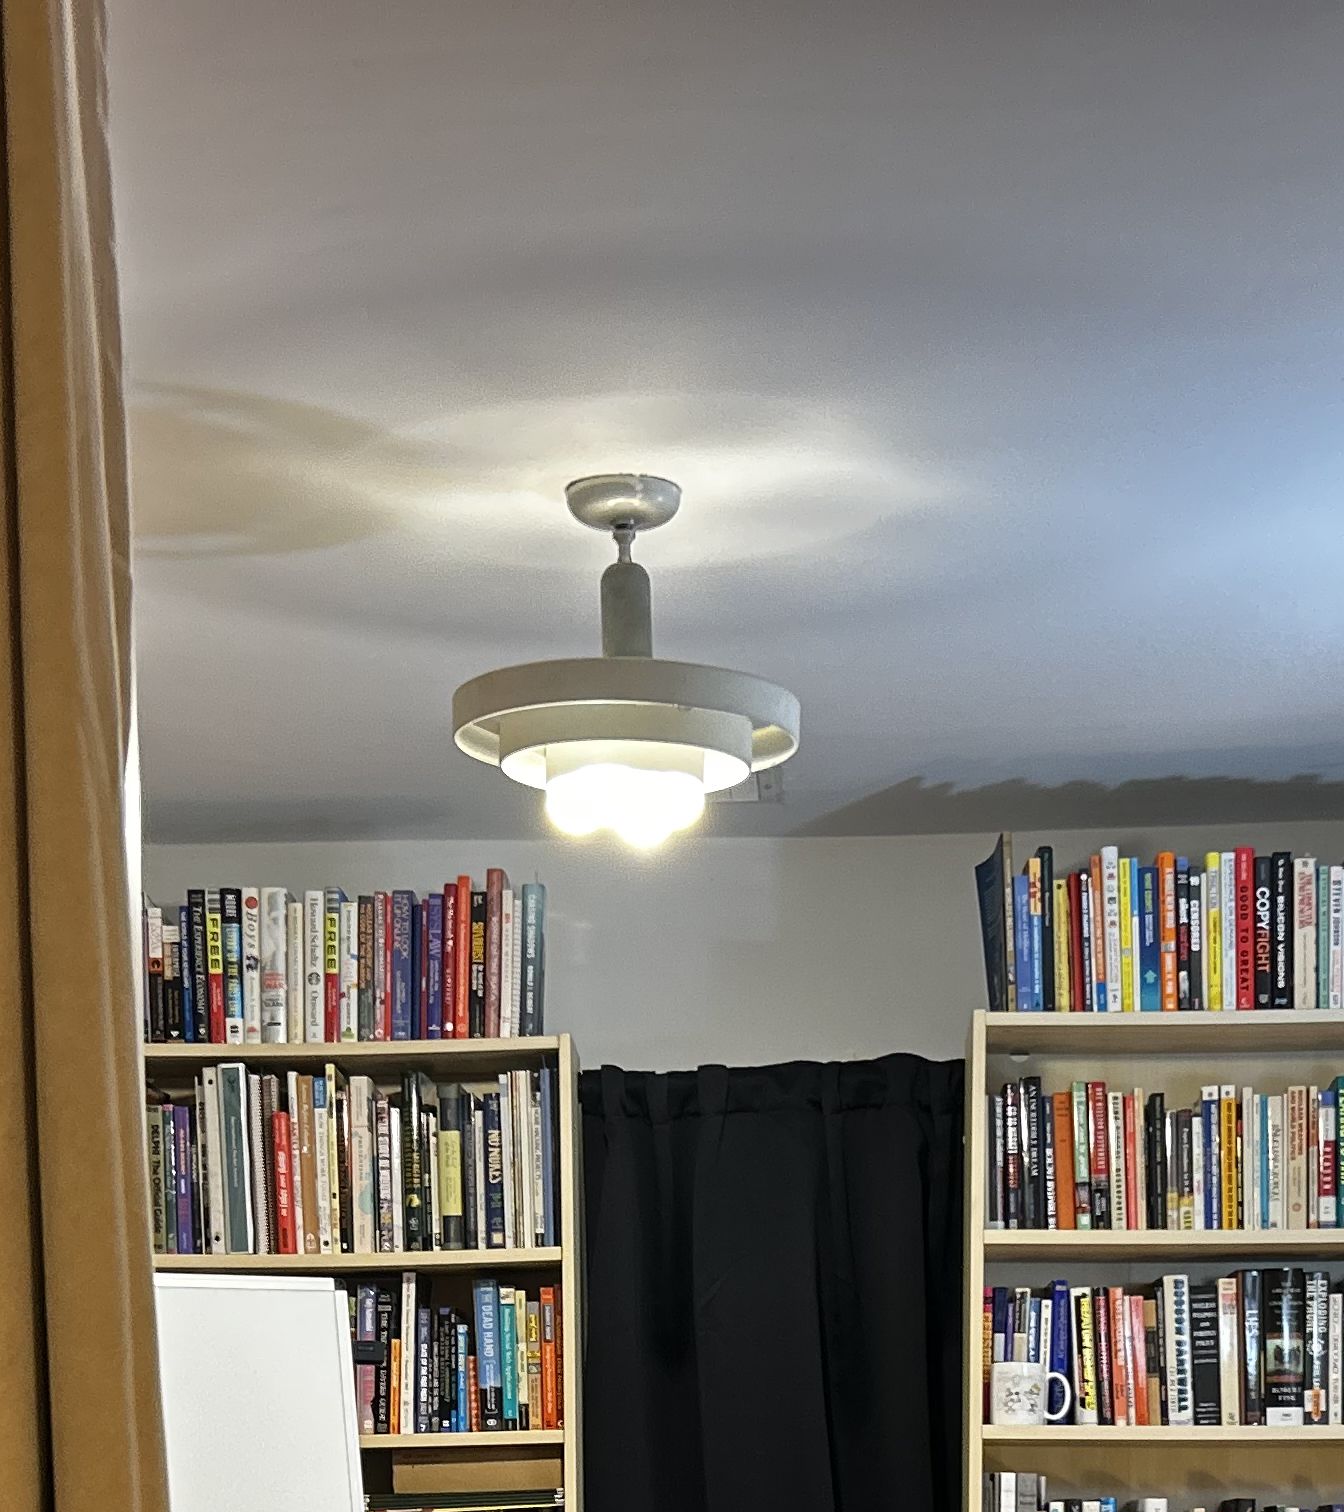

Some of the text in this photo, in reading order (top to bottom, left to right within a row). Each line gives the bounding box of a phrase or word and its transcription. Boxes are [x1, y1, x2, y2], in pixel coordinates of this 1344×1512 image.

[1331, 879, 1343, 914] STEVEN
[194, 925, 204, 972] EXPERIENCE
[209, 917, 219, 970] FREE
[246, 912, 257, 949] Boys
[309, 897, 319, 967] Howard Schultz
[327, 917, 337, 970] FREE
[394, 918, 402, 949] ONLINE
[401, 895, 409, 959] HOW TO LOOK
[1190, 900, 1200, 951] CENSORED
[1239, 886, 1250, 992] GOOD TO GREAT
[1255, 886, 1270, 973] COPYFIGHT
[1276, 895, 1286, 988] SILICON VISIONS
[195, 974, 205, 1015] ECONOMY
[310, 990, 319, 1026] Onward
[1029, 1085, 1036, 1097] AN
[151, 1125, 163, 1235] DELPHI The Official Guide
[488, 1129, 502, 1184] NO NUKES
[1030, 1148, 1038, 1177] DREAM
[1317, 1280, 1327, 1334] EXPLODING
